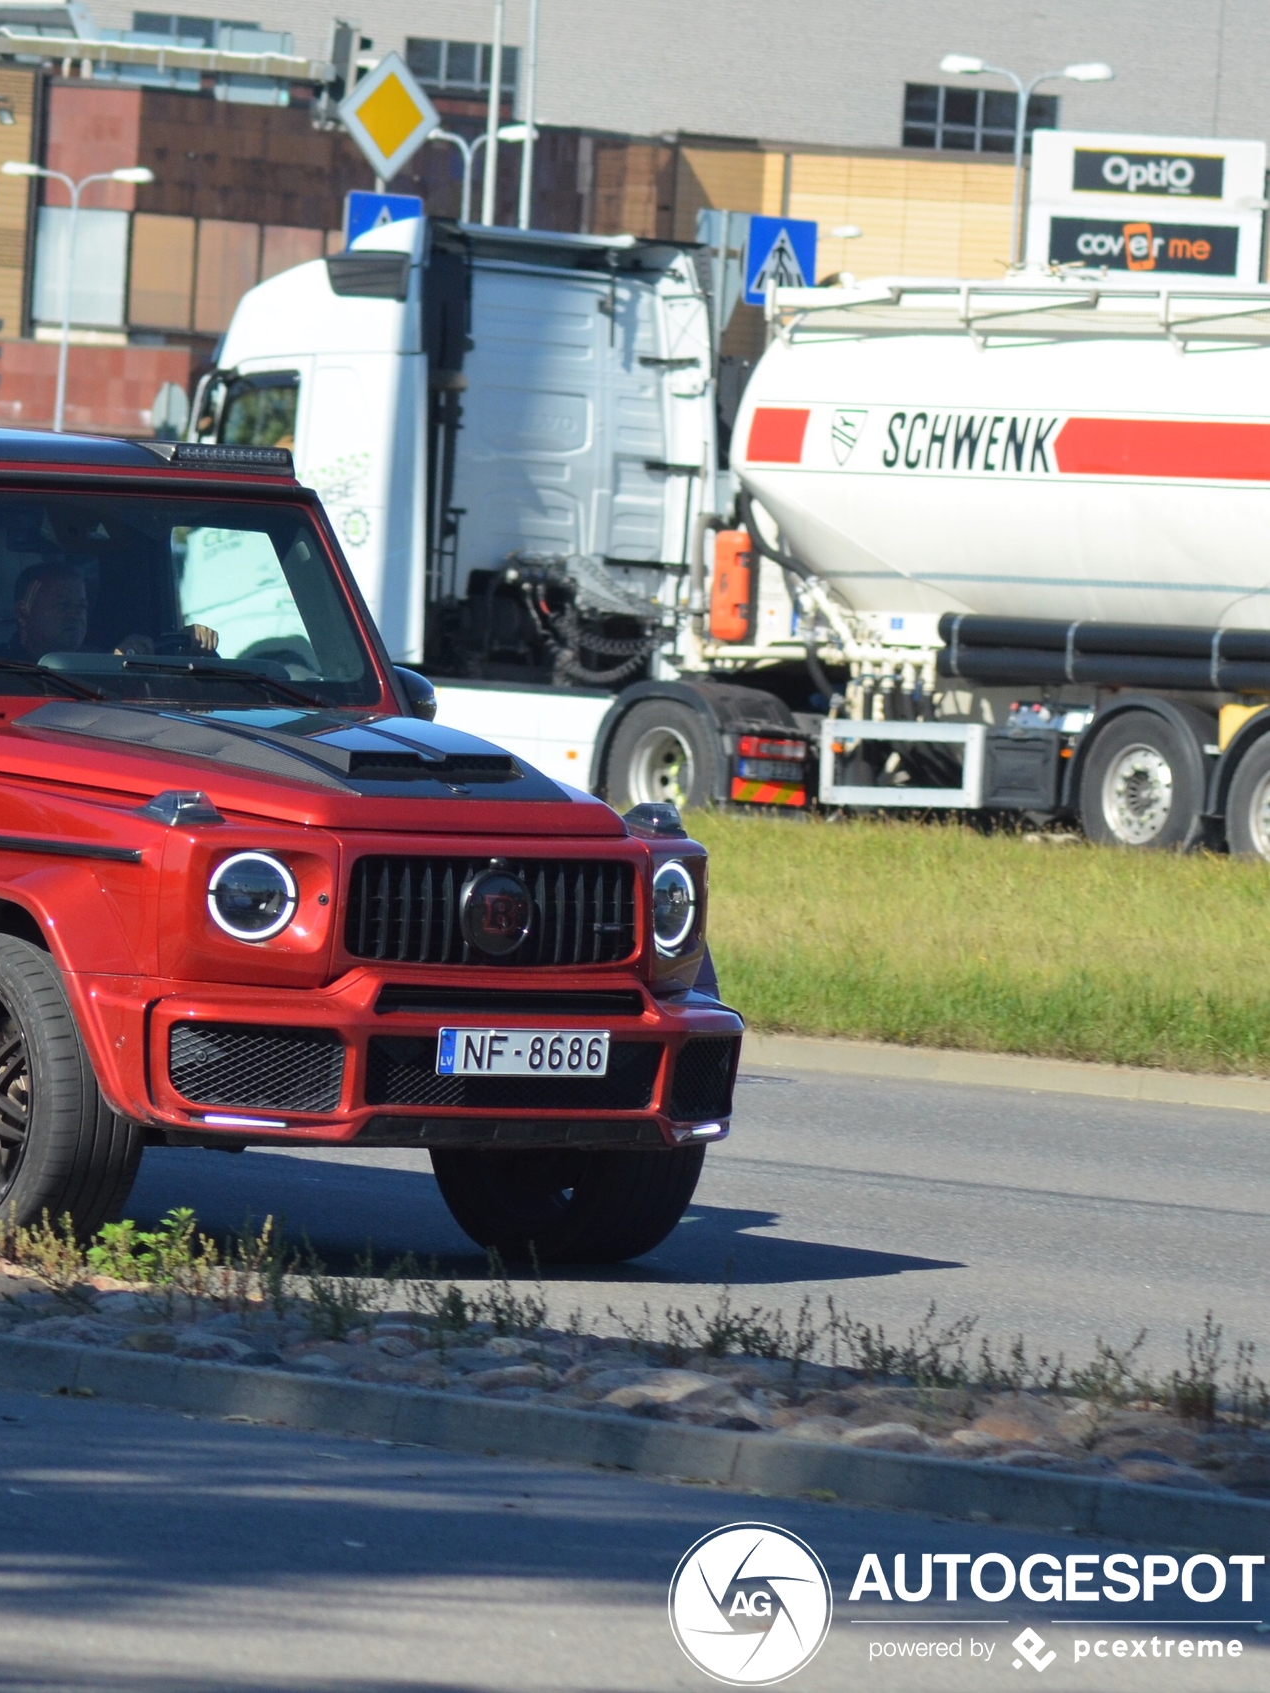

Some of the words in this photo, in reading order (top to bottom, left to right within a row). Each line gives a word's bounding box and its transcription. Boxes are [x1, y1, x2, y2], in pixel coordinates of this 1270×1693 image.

[1076, 233, 1165, 258] cover
[1168, 238, 1211, 260] me
[883, 411, 1058, 474] SCHWENK
[440, 1056, 453, 1067] LV
[462, 1034, 603, 1071] NF-8686
